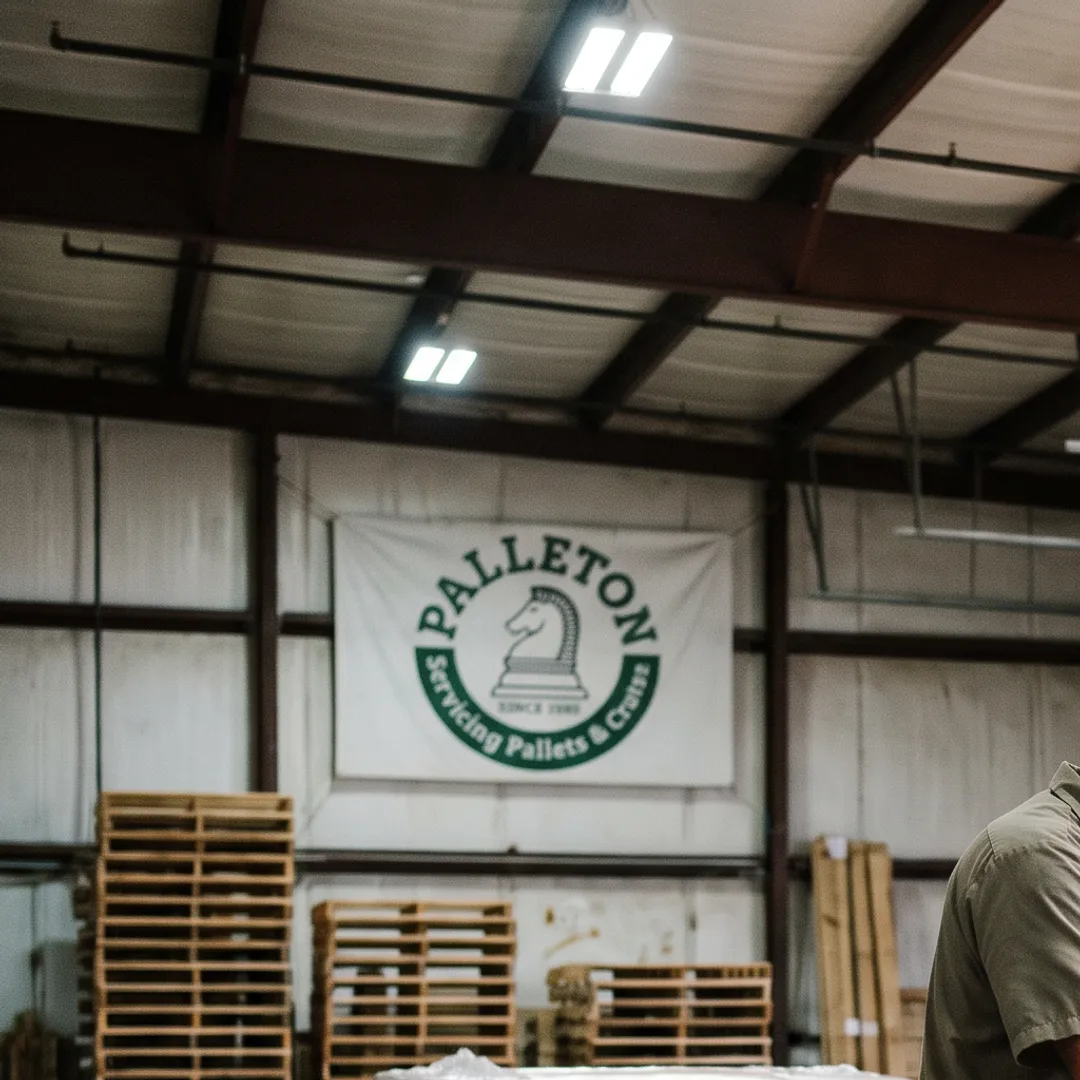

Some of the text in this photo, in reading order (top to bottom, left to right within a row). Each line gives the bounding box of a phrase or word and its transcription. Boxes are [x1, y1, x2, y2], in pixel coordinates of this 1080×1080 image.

[418, 534, 658, 646] PALLETON
[425, 655, 503, 755] Servicing
[505, 735, 588, 761] Pallets
[588, 724, 609, 744] &
